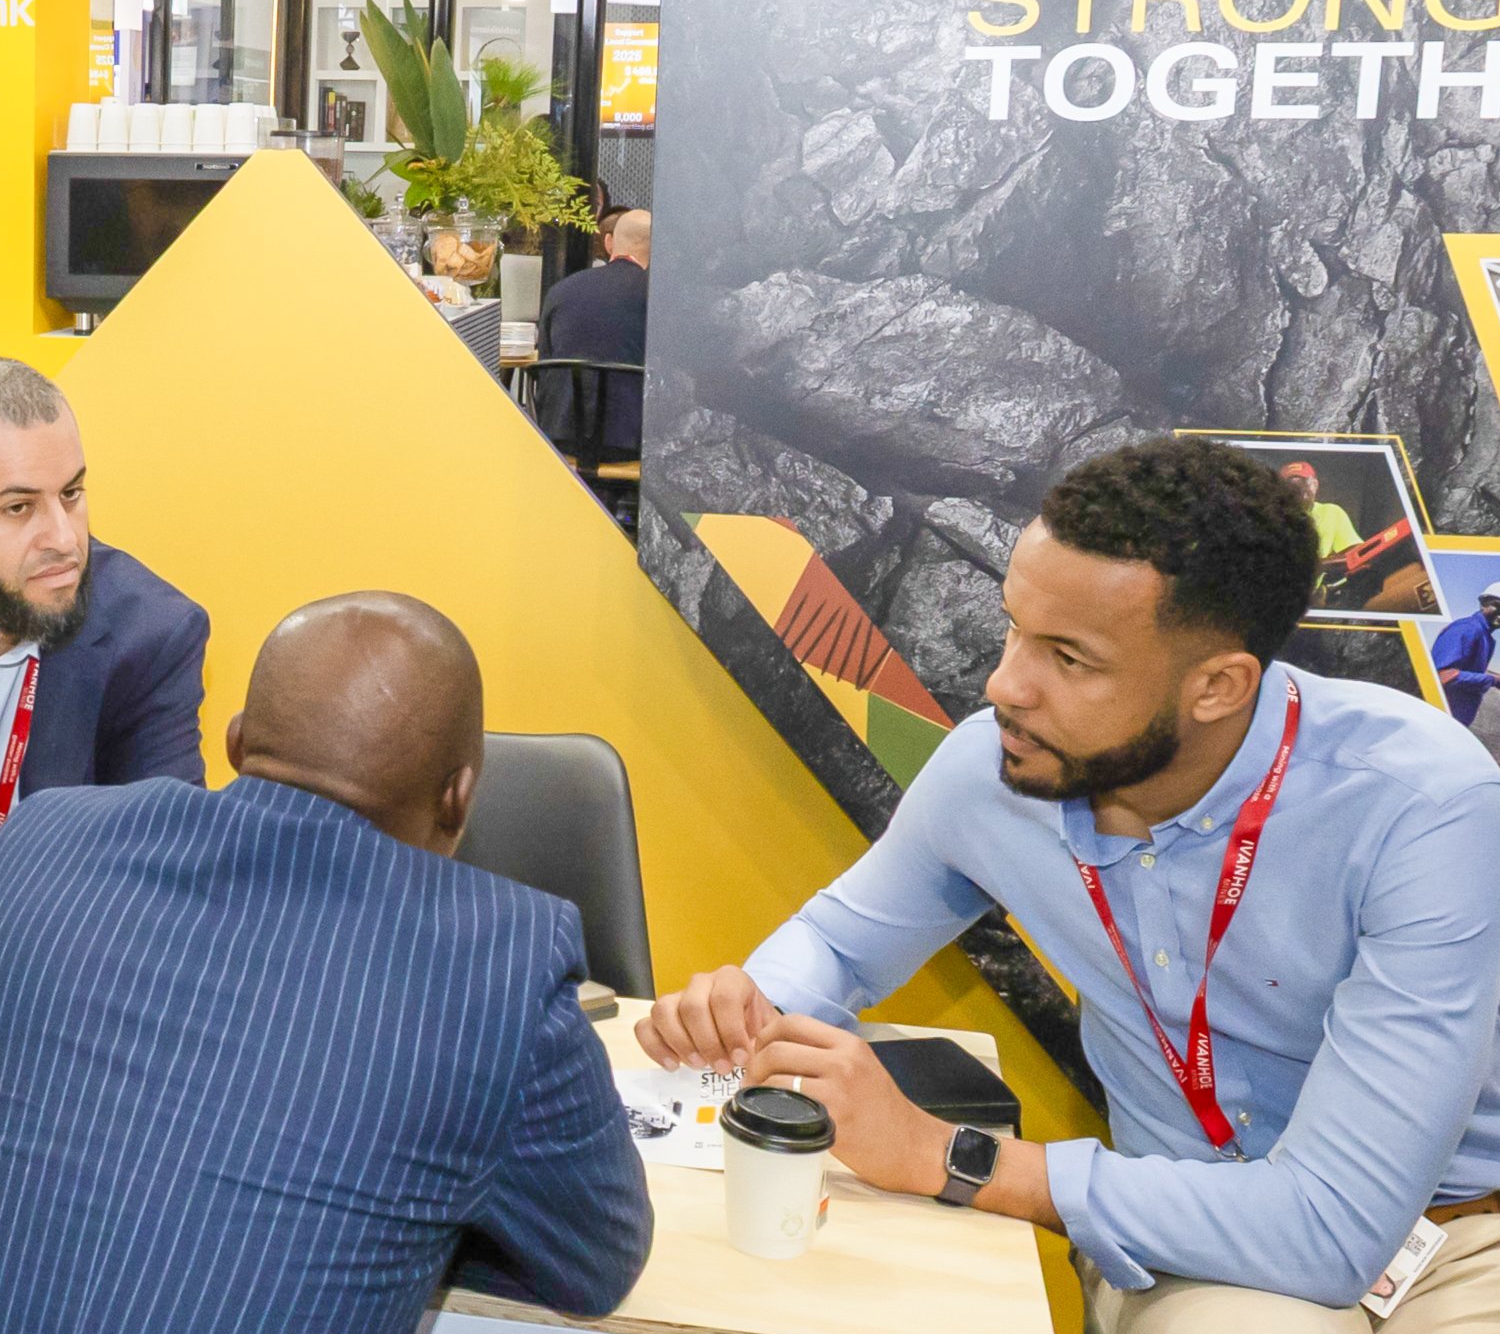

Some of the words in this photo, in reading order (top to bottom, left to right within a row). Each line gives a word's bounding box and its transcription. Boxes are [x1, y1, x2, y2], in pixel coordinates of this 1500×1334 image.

[1270, 774, 1281, 795] with
[1224, 839, 1254, 905] IVANHOE
[1196, 1032, 1213, 1089] IVANHOE
